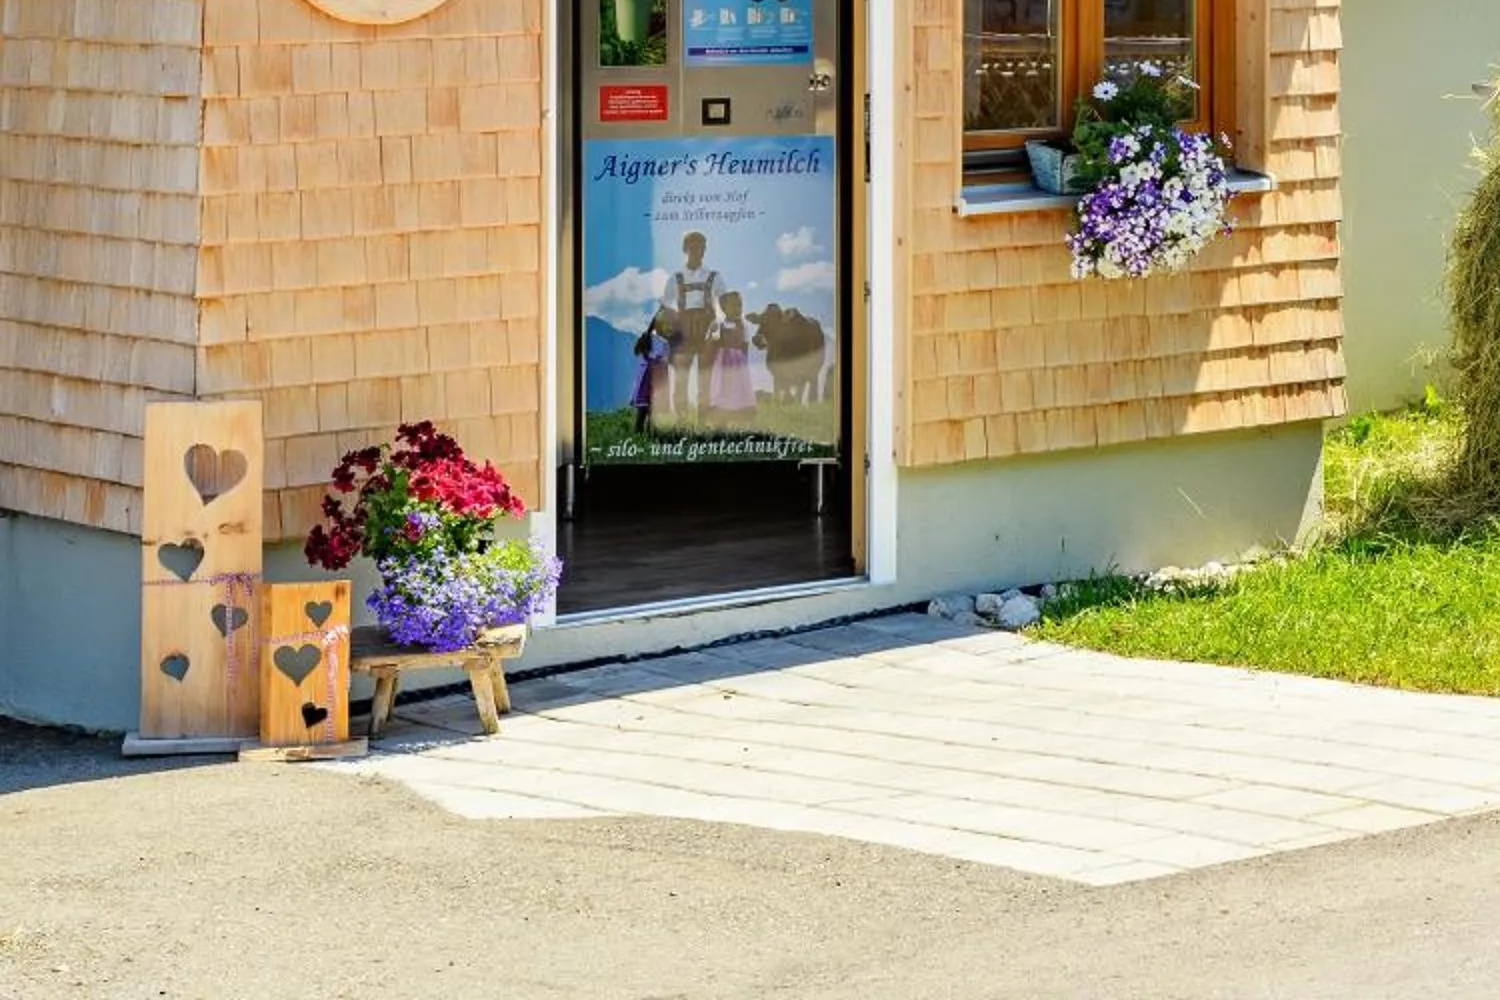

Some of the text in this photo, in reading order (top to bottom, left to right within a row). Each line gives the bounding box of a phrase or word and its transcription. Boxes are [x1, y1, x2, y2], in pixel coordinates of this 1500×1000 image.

[594, 148, 820, 184] Aigner's Heumilch
[651, 436, 687, 456] und
